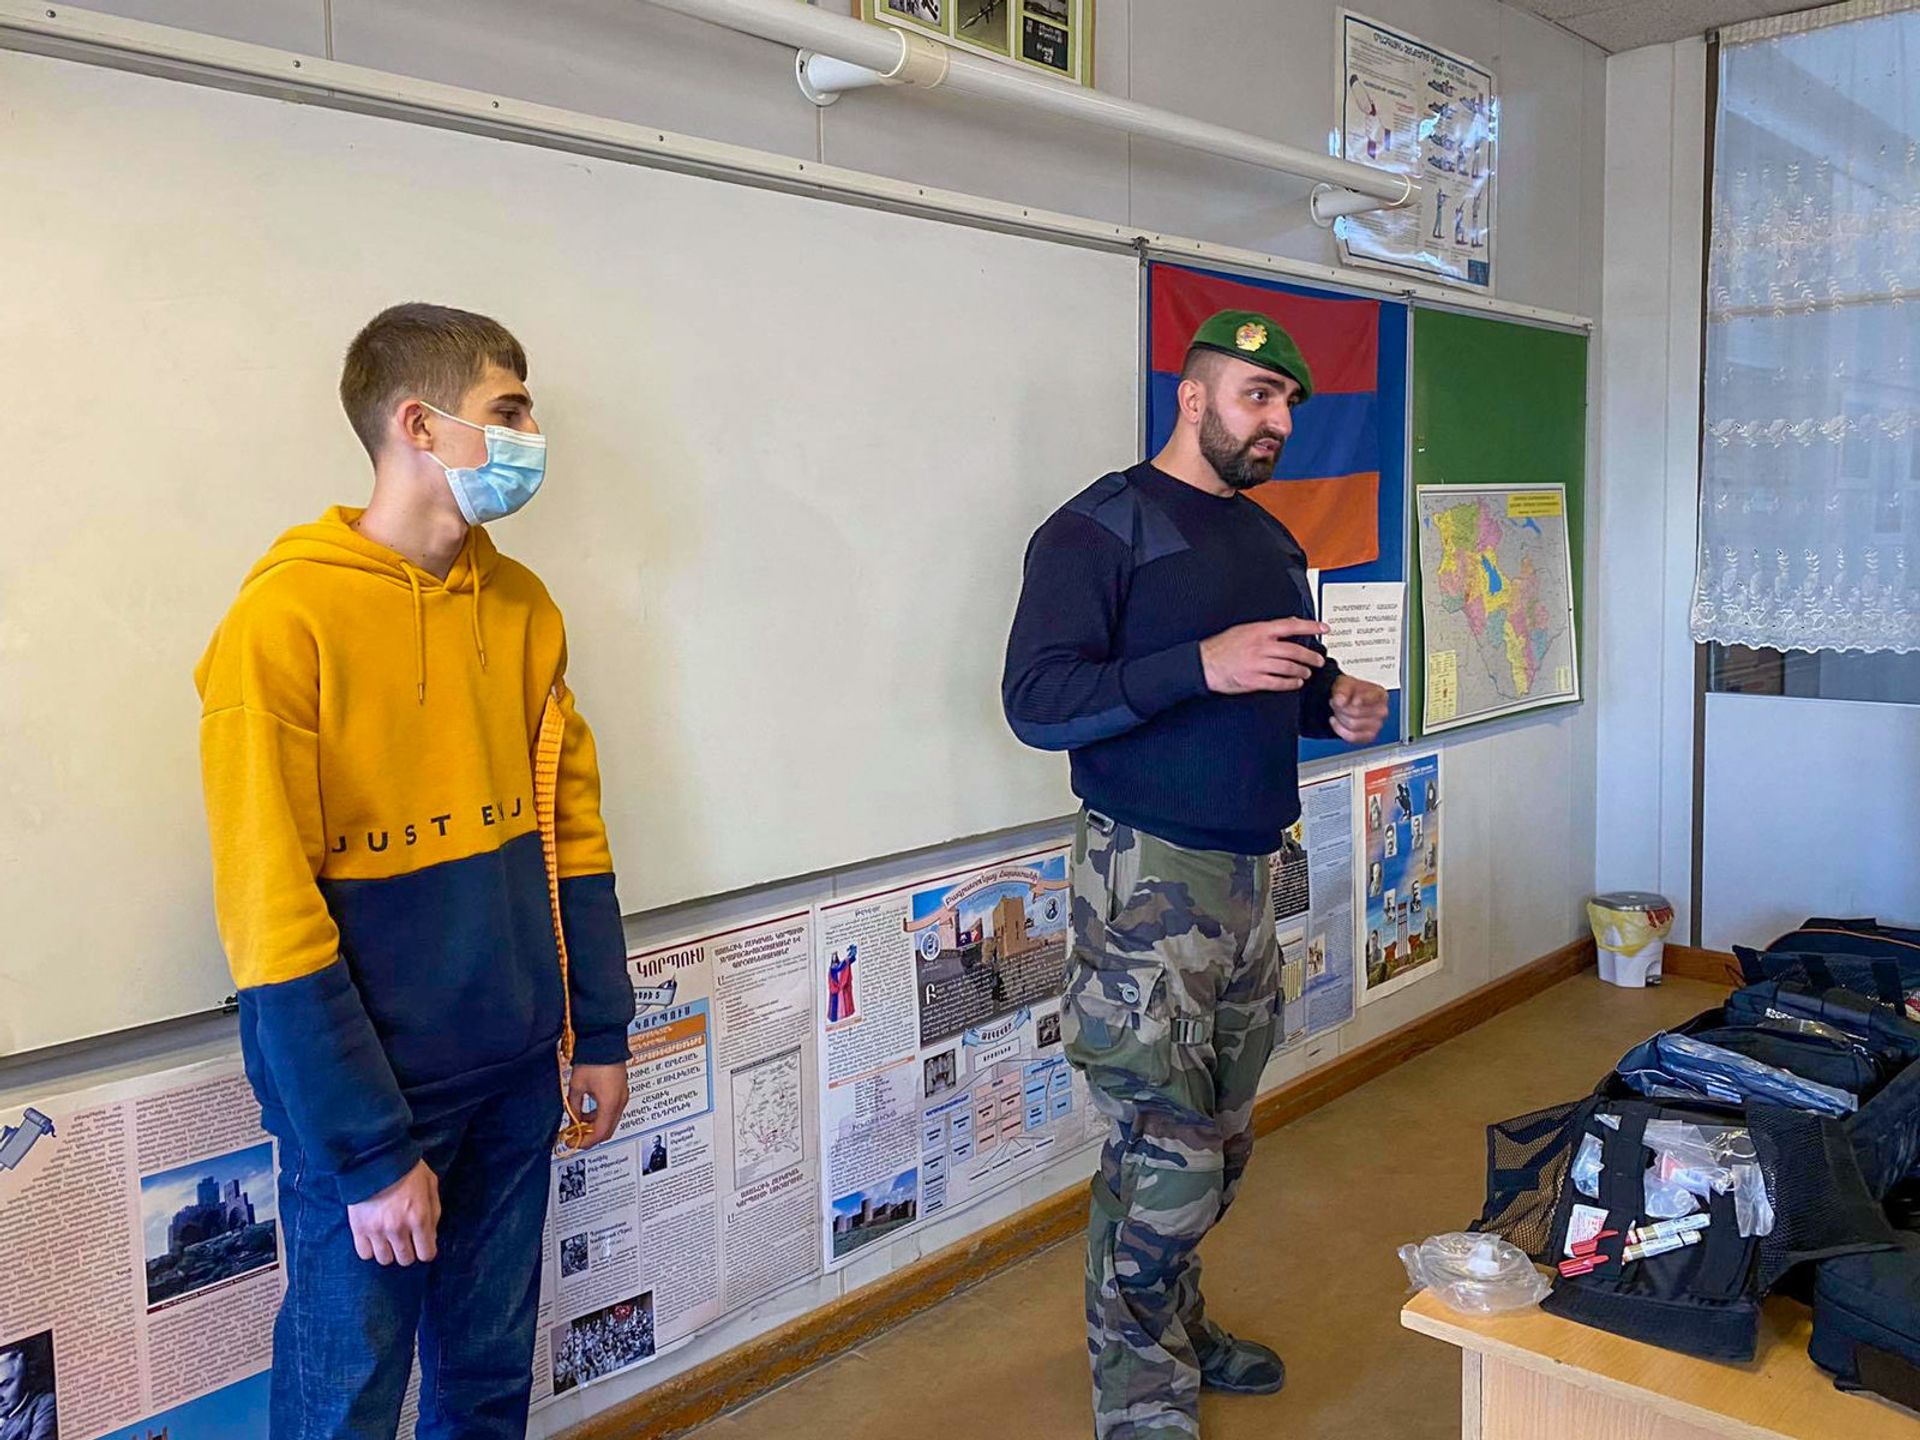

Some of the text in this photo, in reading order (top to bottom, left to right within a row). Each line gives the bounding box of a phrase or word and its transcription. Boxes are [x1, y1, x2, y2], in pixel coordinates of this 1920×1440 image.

[332, 814, 451, 852] JUST
[636, 947, 705, 978] ԿՈՐՊՈՒՍ
[634, 1006, 690, 1029] ԿՈՐՊՈՒՍ
